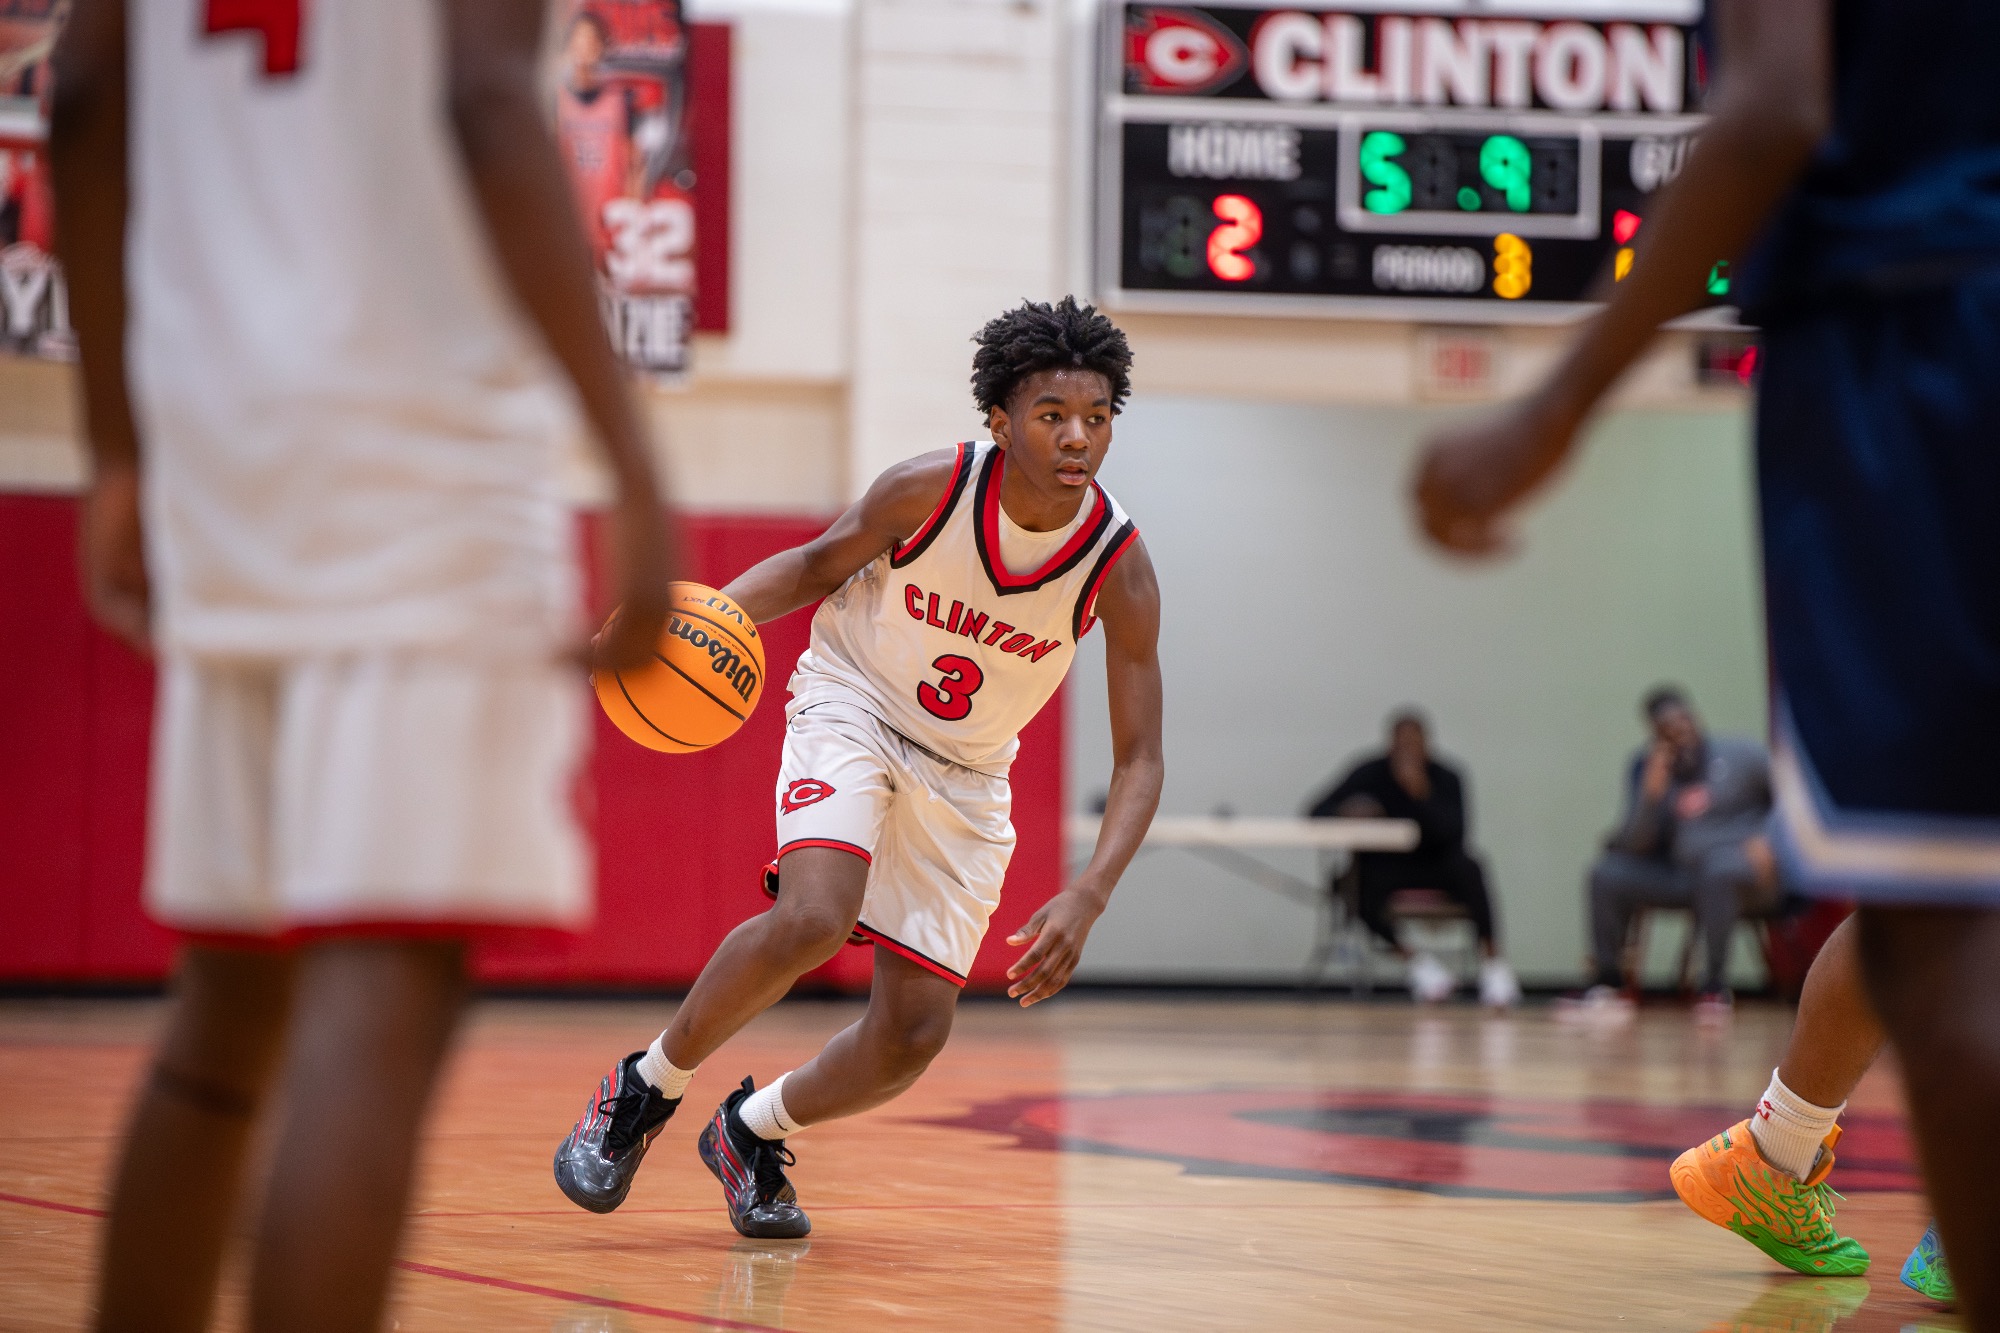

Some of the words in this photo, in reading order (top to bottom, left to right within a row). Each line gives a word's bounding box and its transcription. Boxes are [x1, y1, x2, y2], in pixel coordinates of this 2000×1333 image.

[1251, 11, 1684, 113] CLINTON
[1168, 122, 1301, 181] HOME
[602, 200, 697, 284] 32
[1207, 194, 1263, 281] 2
[705, 596, 757, 638] EVO
[905, 584, 1062, 663] CLINTON
[668, 615, 757, 703] Wilson
[917, 654, 984, 721] 3
